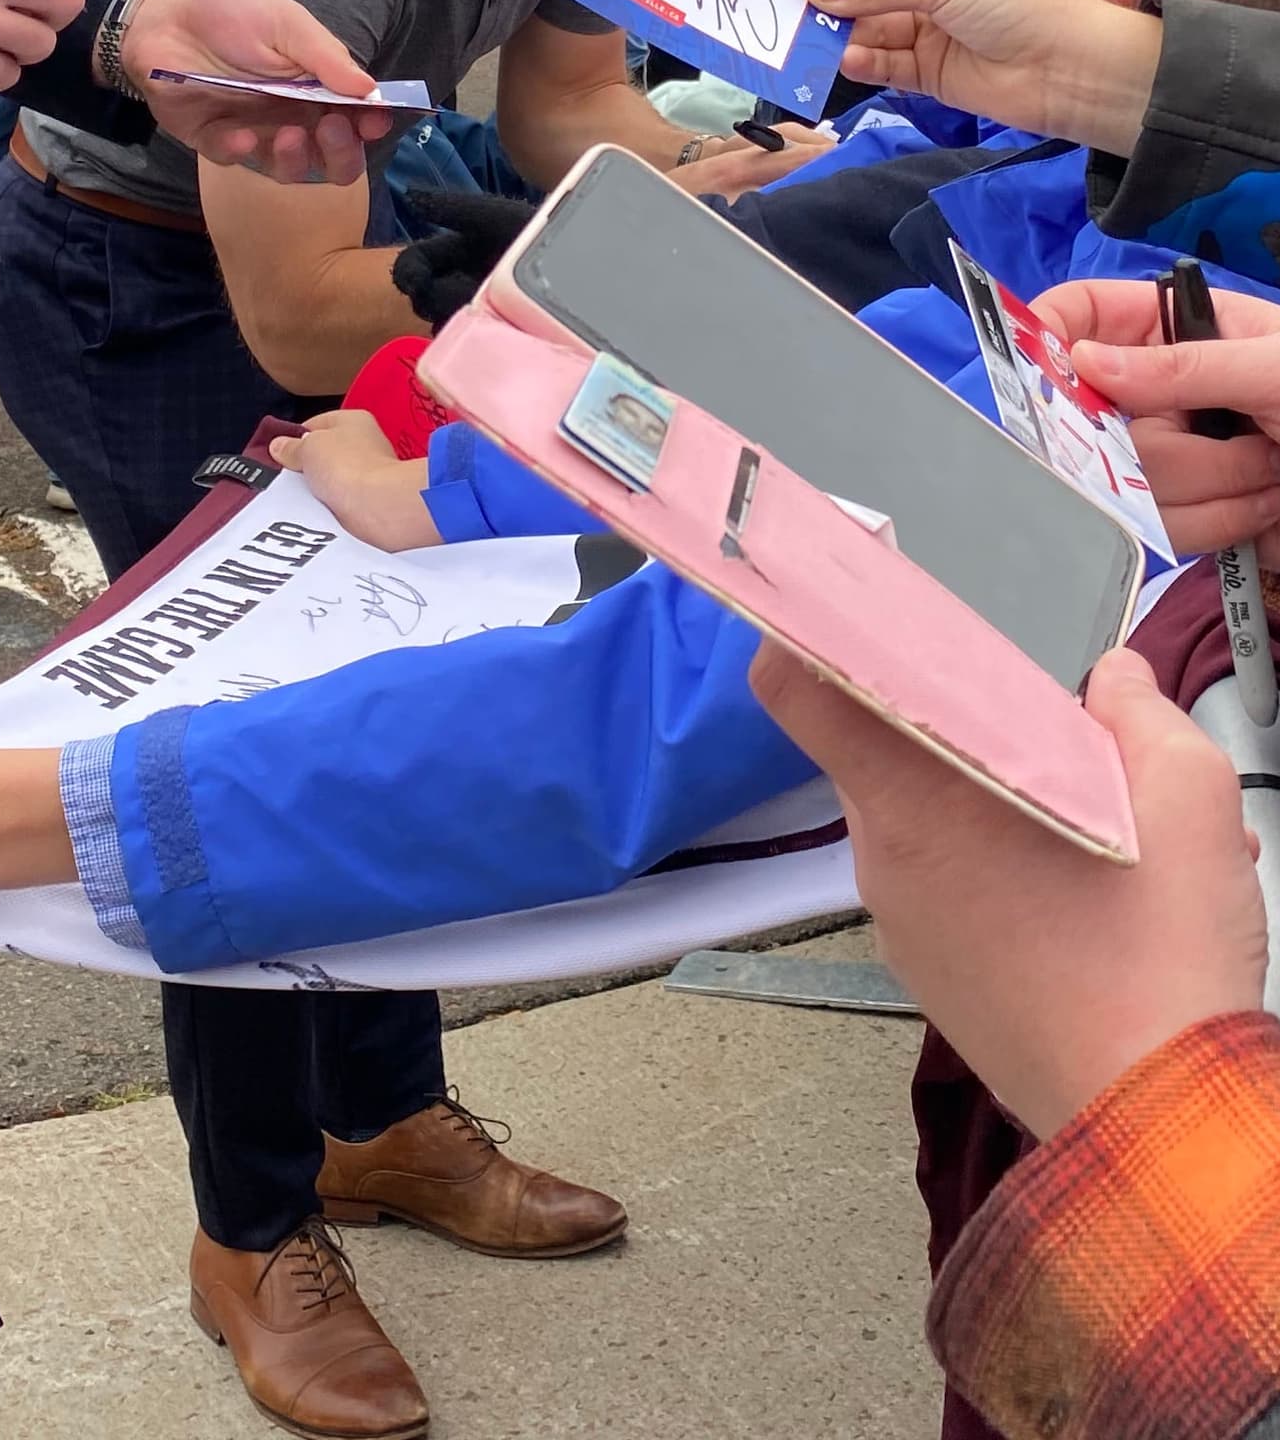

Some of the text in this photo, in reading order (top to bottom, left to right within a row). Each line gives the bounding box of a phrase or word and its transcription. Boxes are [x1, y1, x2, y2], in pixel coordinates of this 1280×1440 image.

[240, 521, 338, 568] GET
[203, 559, 295, 595] IN
[142, 587, 261, 642] THE
[41, 626, 197, 710] GAME
